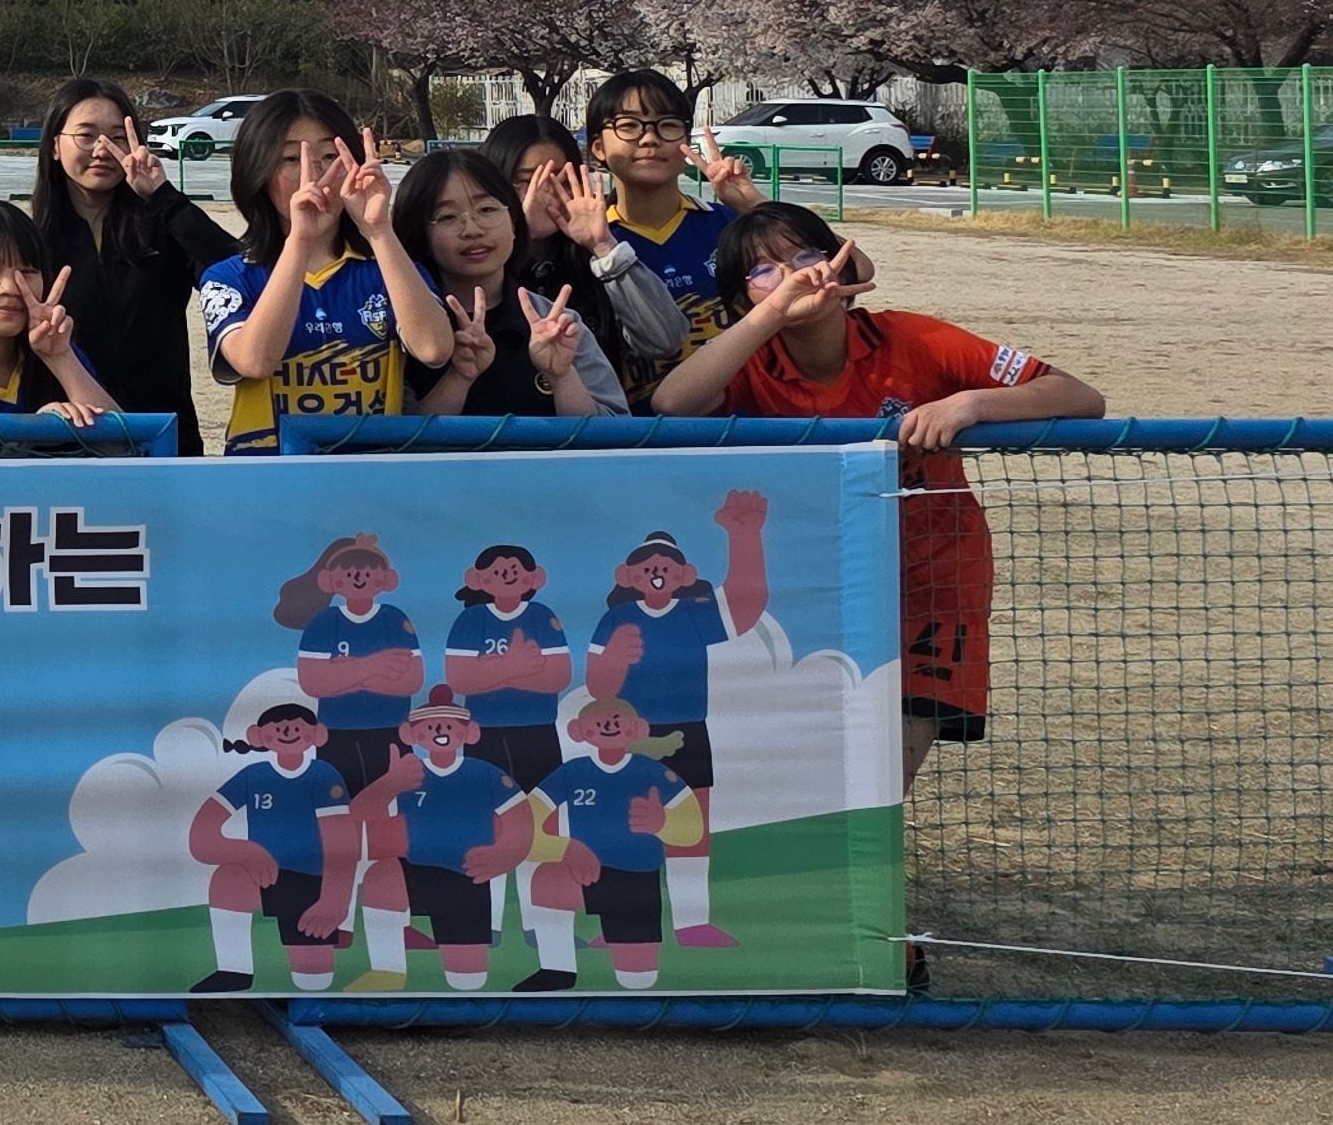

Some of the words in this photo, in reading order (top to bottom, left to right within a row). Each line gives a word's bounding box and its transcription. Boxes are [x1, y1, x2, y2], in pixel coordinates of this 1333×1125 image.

[337, 641, 351, 658] 9
[484, 637, 509, 657] 26
[252, 792, 274, 810] 13
[414, 791, 427, 807] 7
[572, 789, 597, 806] 22
